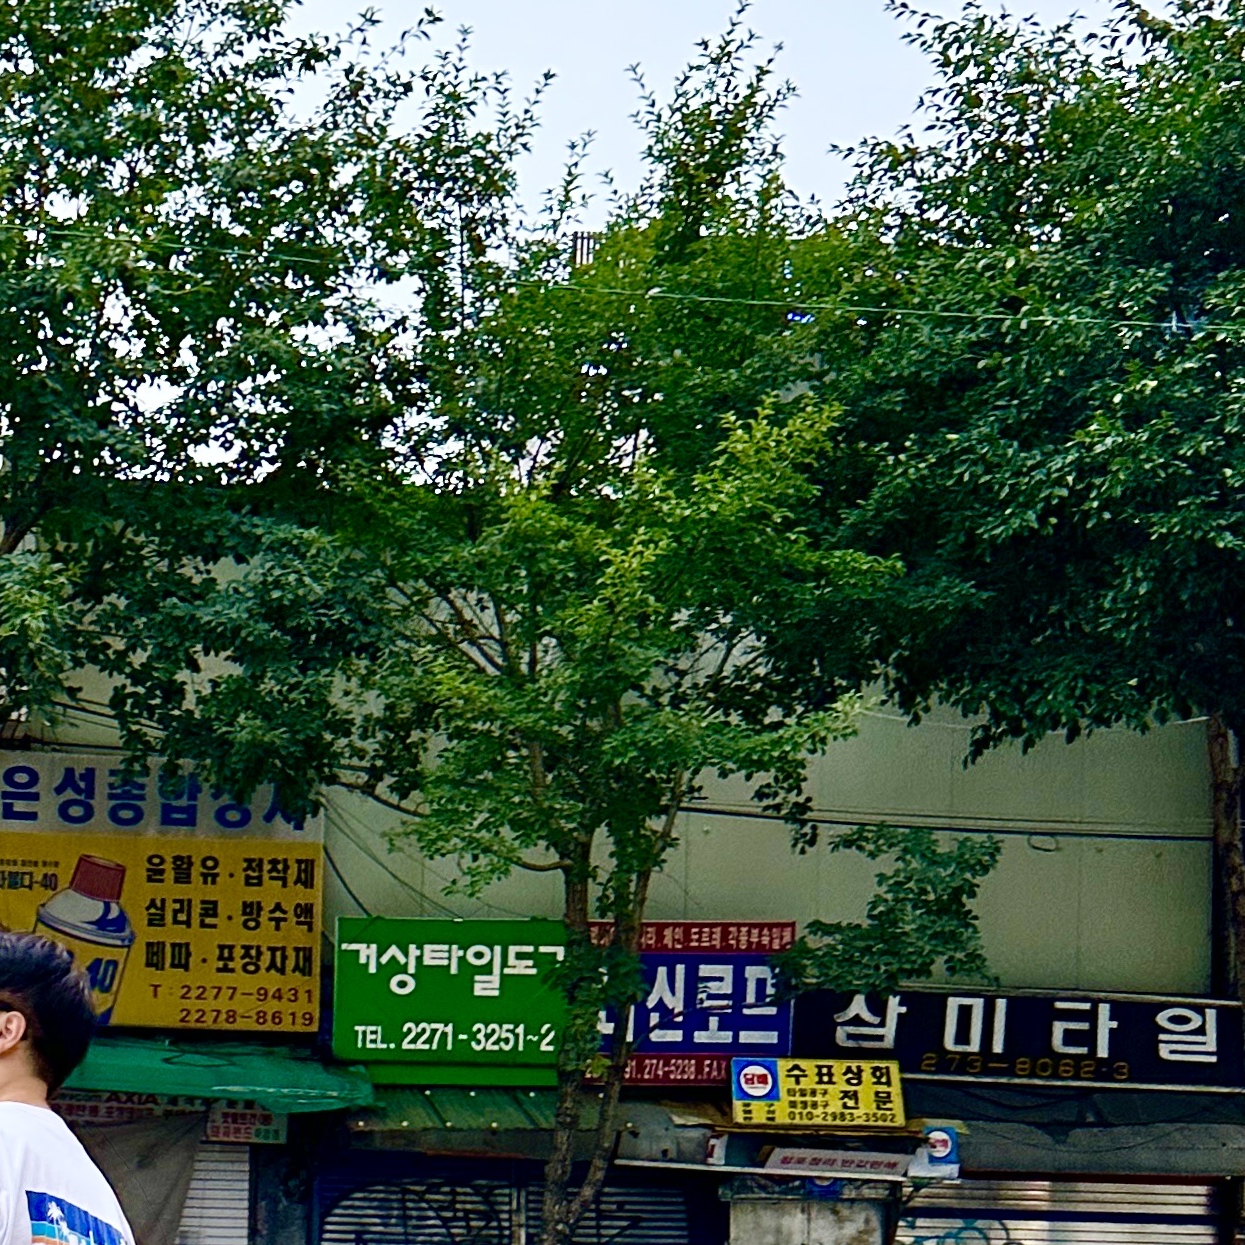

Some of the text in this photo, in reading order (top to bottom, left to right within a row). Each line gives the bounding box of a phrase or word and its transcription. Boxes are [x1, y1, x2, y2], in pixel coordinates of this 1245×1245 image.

[145, 898, 315, 933] 실리콘 방수액
[215, 943, 313, 977] 포장자재
[180, 985, 314, 1004] 2277-9431
[179, 1008, 314, 1027] 2278-8619
[786, 1063, 893, 1088] 수표상회
[839, 1089, 894, 1112] 전문
